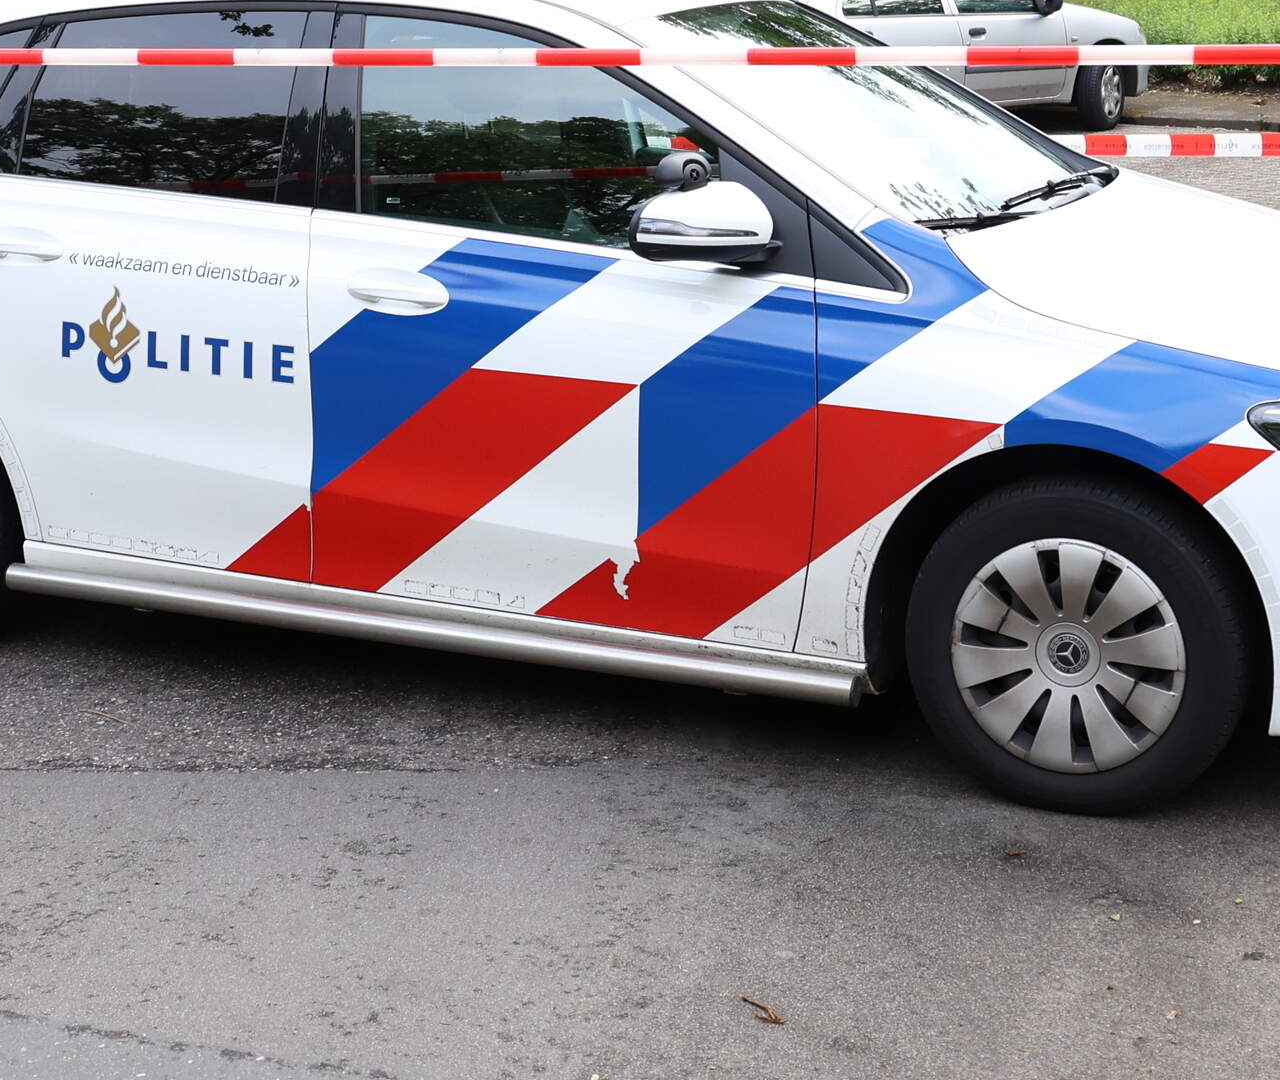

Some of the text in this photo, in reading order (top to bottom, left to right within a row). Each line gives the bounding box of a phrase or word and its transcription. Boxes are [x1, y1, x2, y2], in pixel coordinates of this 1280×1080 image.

[82, 252, 169, 274] waakzaam
[172, 261, 192, 276] en
[195, 260, 287, 287] dienstbaar
[62, 321, 295, 384] POLITIE
